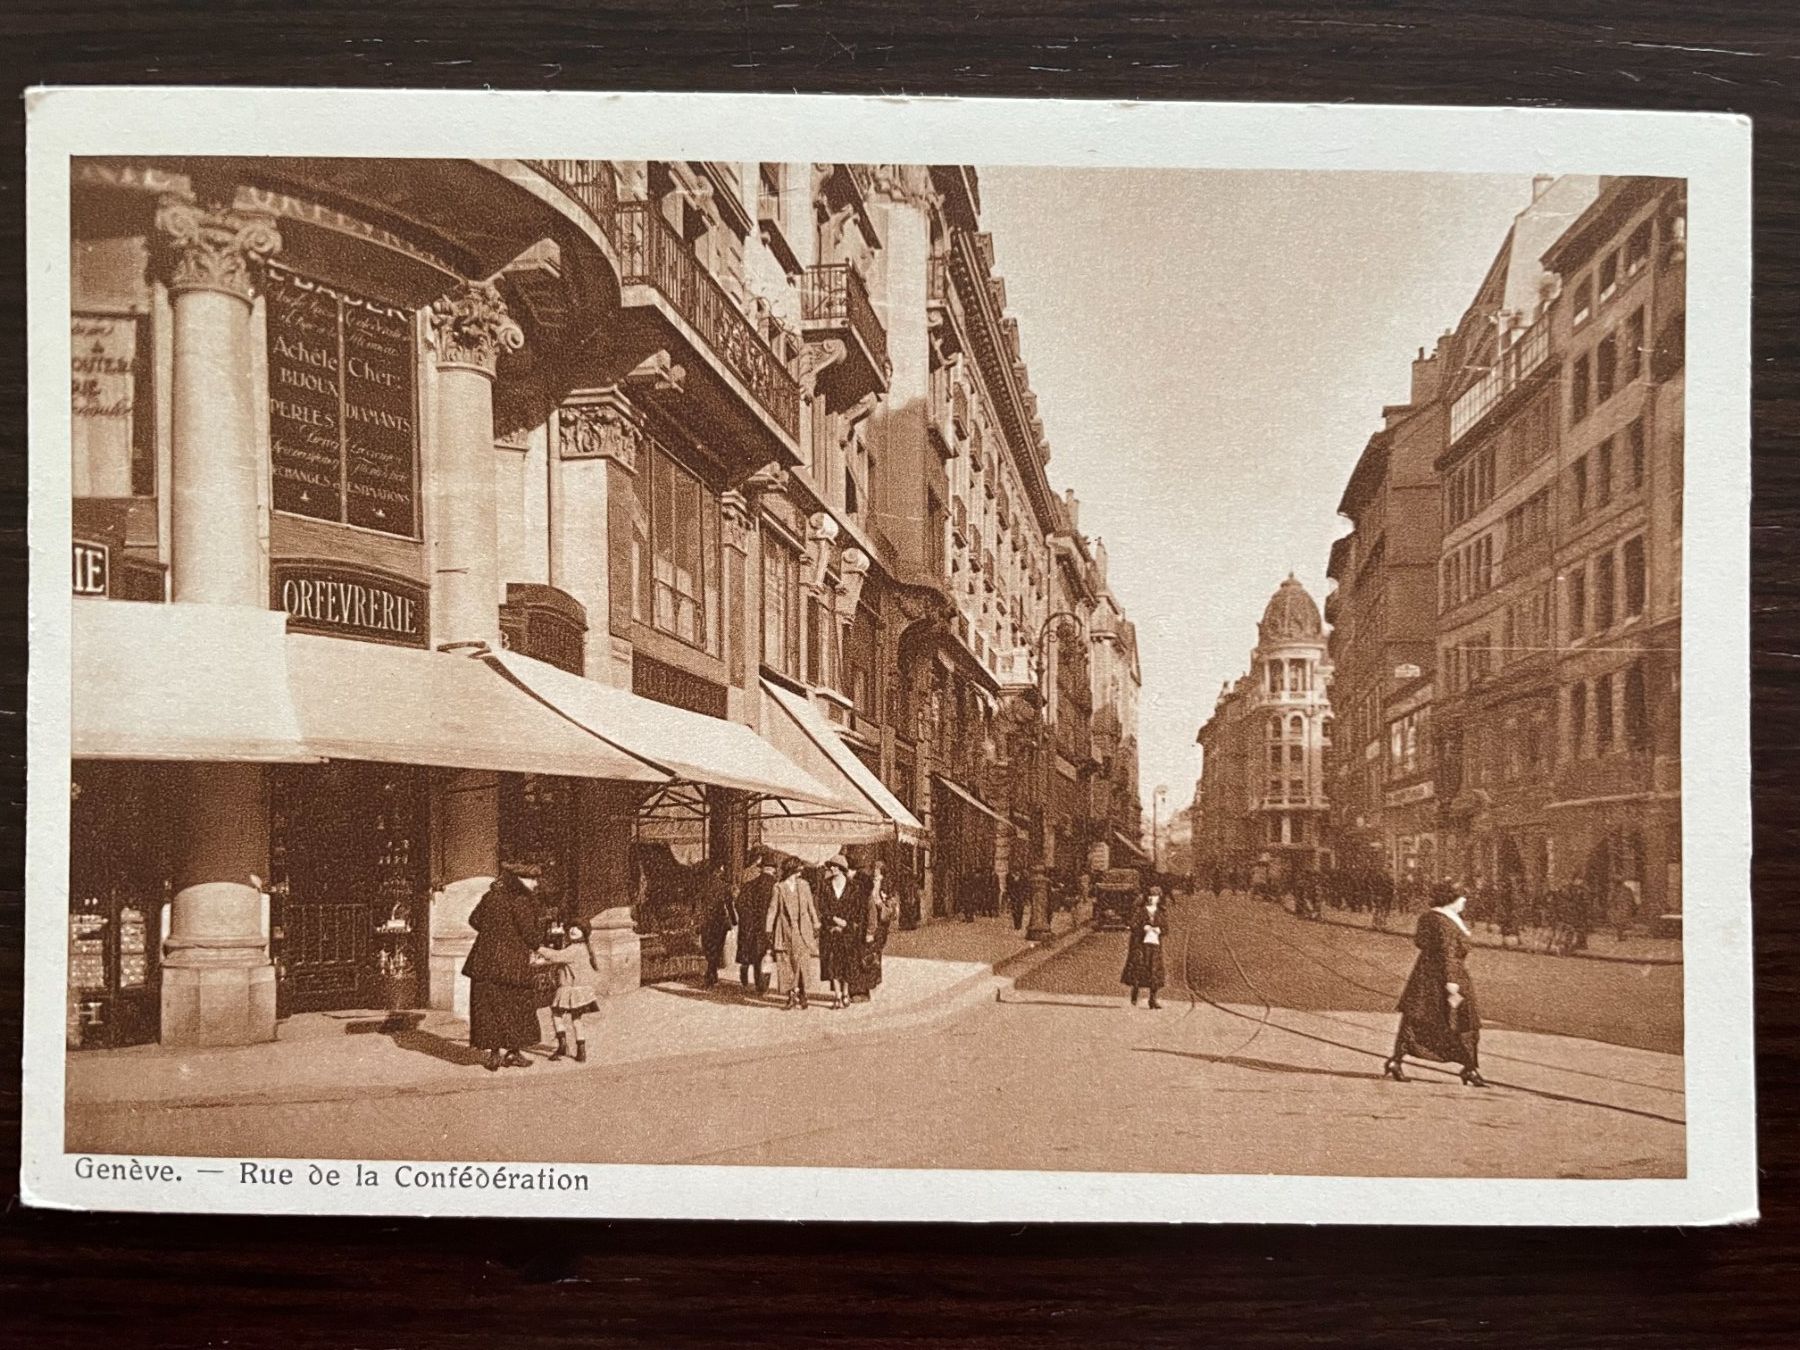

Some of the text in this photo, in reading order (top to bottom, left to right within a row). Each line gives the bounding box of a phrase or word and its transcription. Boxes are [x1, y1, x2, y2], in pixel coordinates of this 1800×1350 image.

[280, 367, 339, 398] BIJOUX
[270, 398, 412, 433] PERLES DIAMANTS
[75, 547, 104, 592] IE
[75, 1157, 182, 1182] Genève.
[240, 1162, 293, 1186] Rue
[308, 1164, 340, 1186] de
[355, 1164, 379, 1187] la
[395, 1165, 589, 1191] Confédération
